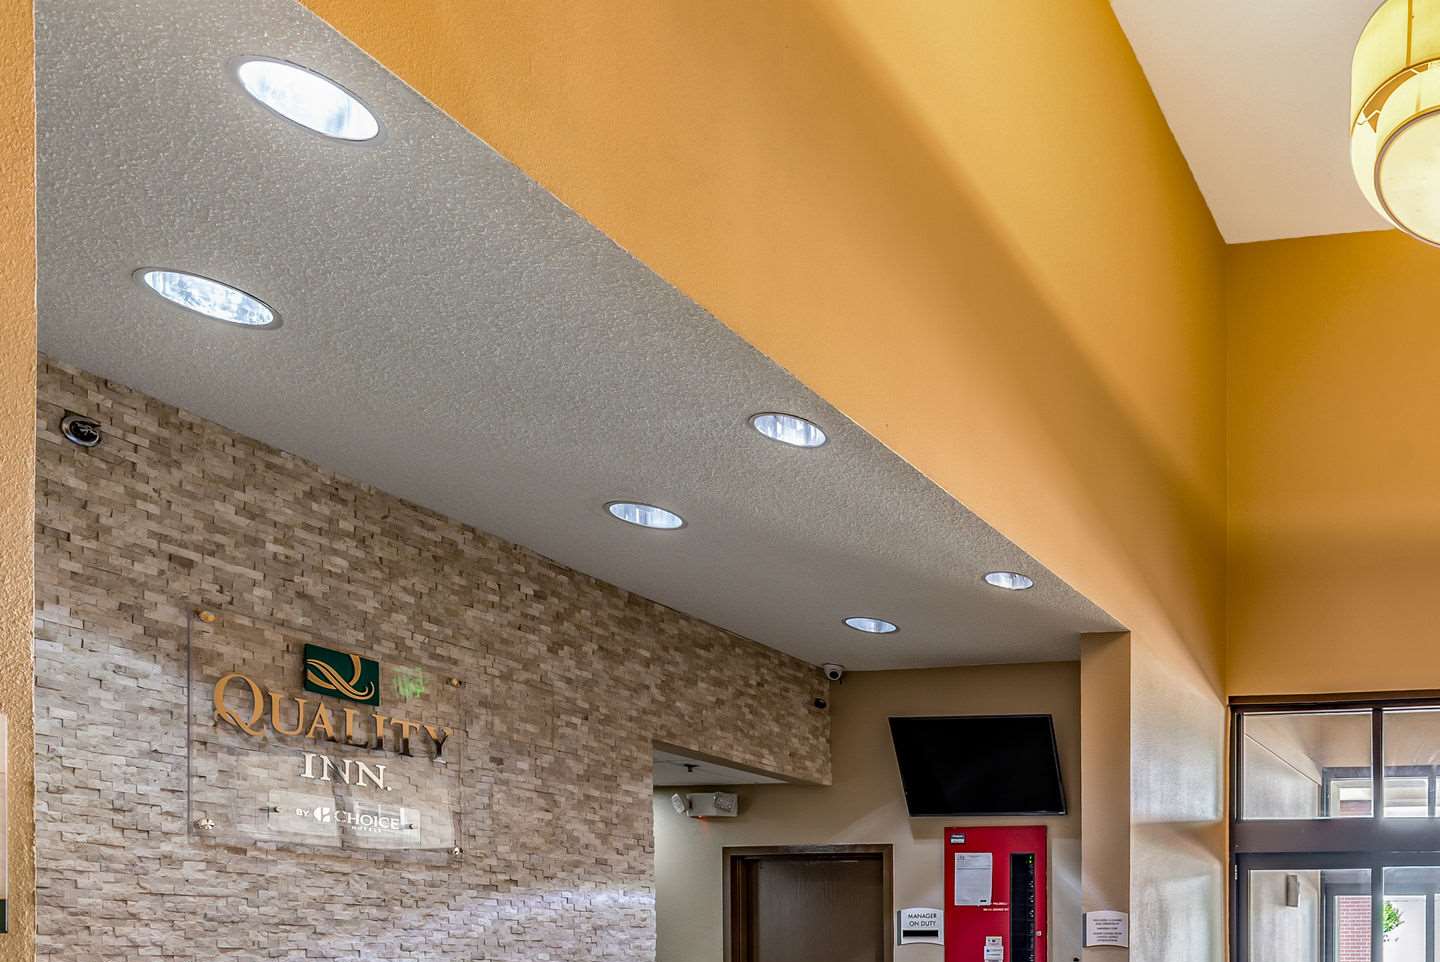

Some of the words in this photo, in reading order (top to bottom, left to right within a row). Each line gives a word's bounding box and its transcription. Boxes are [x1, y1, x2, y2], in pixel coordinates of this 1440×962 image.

[214, 672, 453, 764] QUALITY
[295, 807, 310, 817] BY
[334, 810, 400, 830] CHOICE
